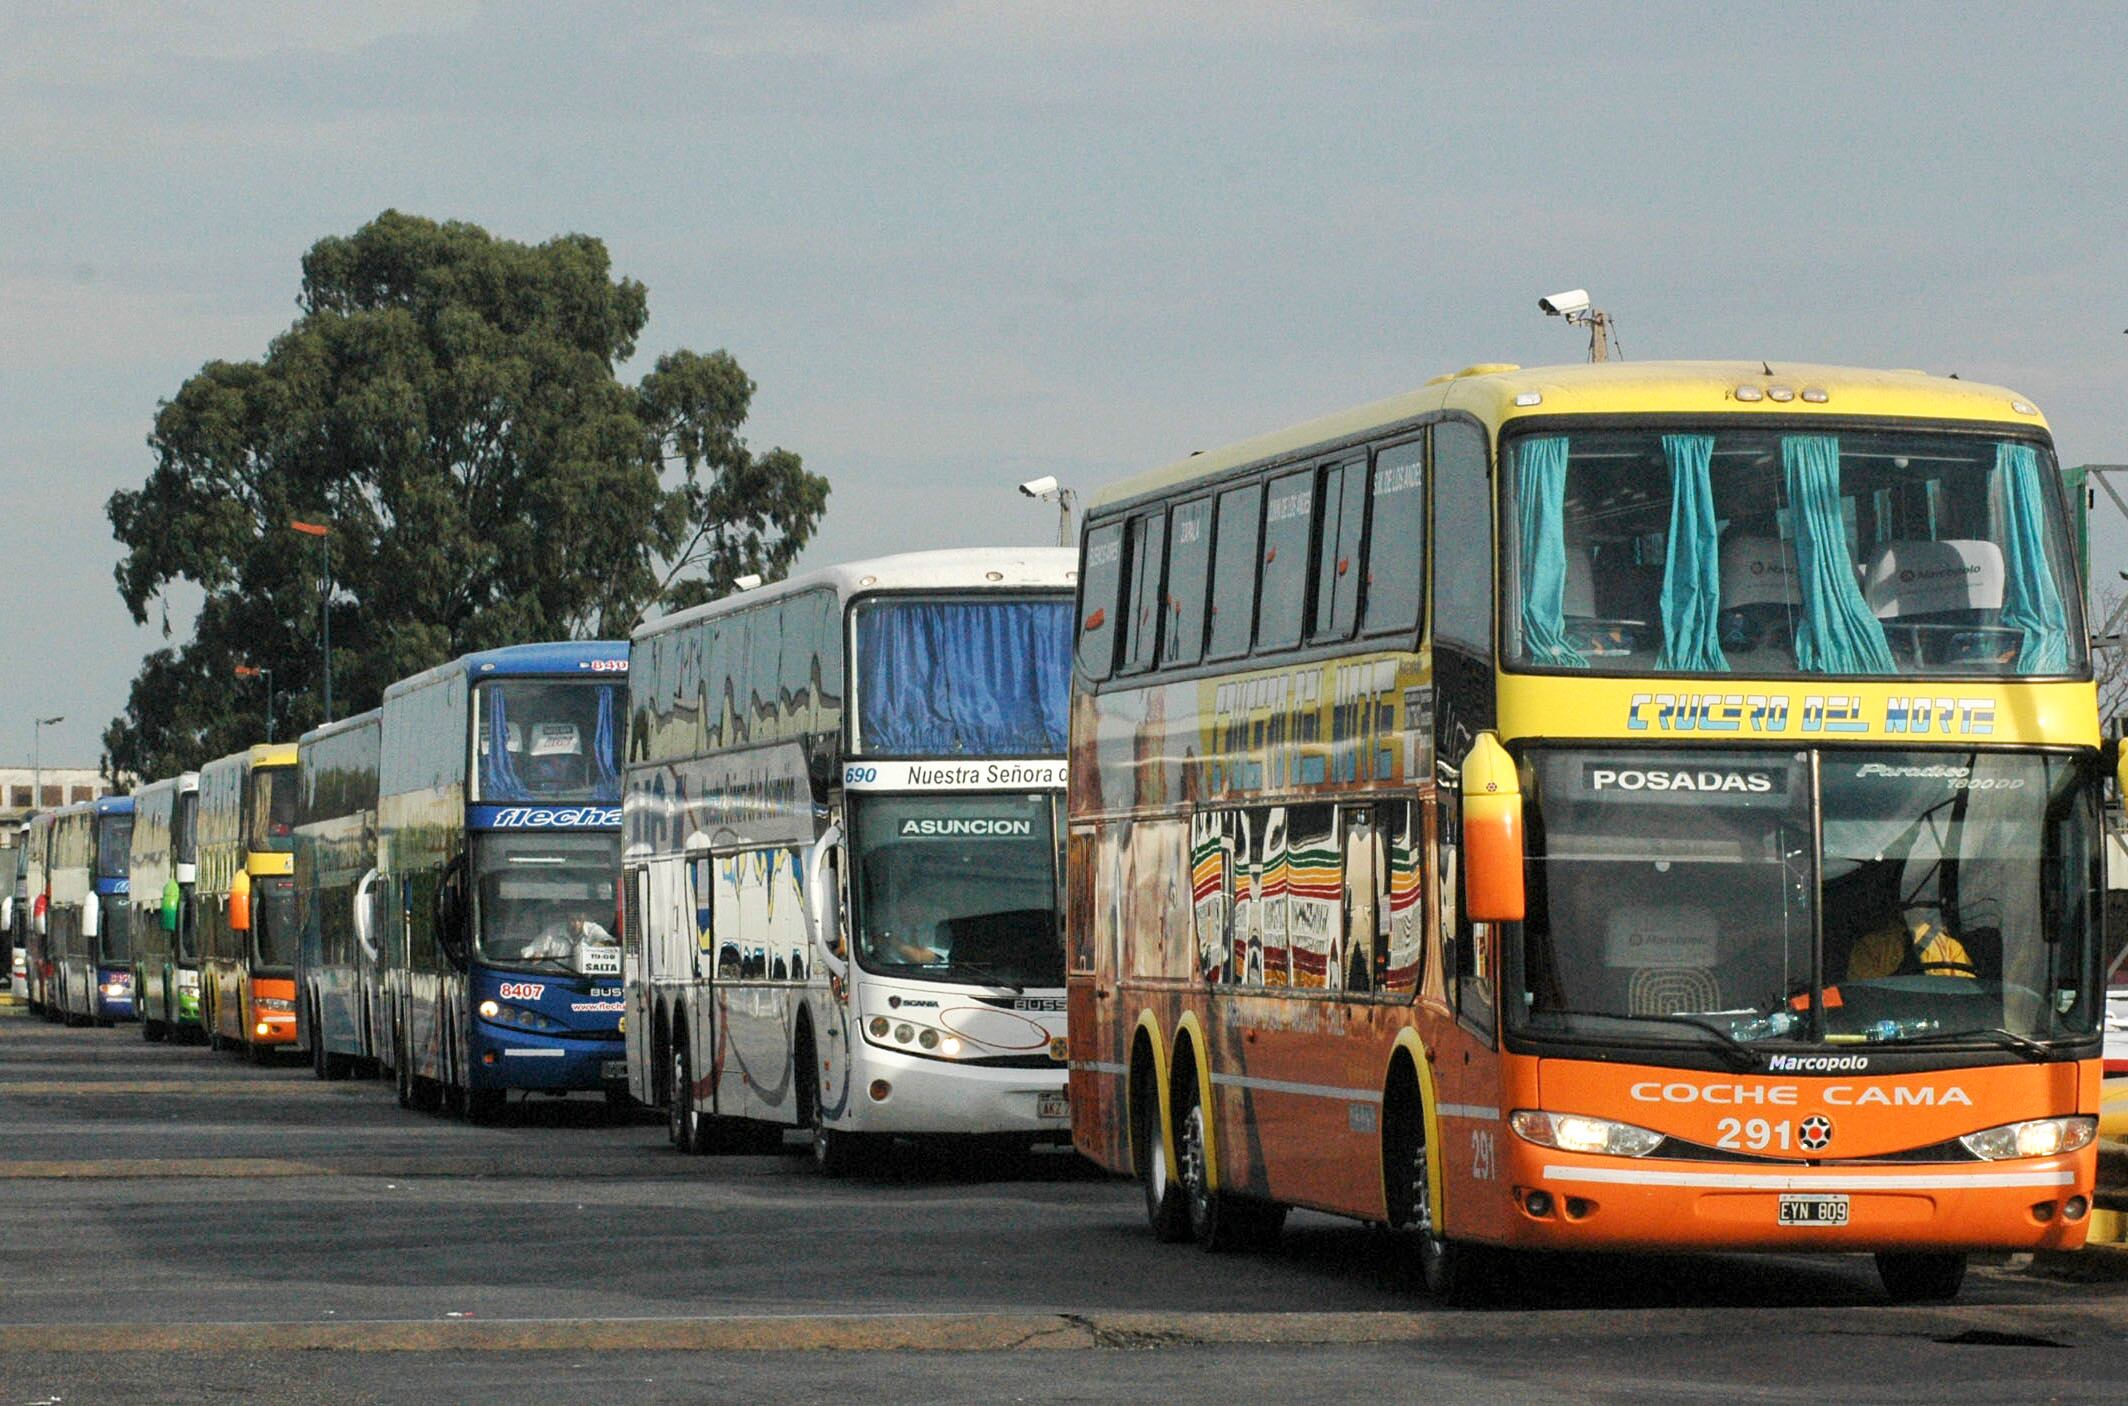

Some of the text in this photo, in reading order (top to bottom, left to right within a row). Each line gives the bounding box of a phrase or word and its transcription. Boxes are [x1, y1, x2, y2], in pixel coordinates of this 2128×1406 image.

[1627, 693, 1996, 735] CRUCERO DEL NORTE
[845, 767, 877, 783] 690
[907, 766, 980, 785] Nuestra
[986, 764, 1053, 784] Señora
[1856, 763, 1970, 778] Paradiso
[1592, 769, 1772, 792] POSADAS
[902, 819, 1031, 835] ASUNCION
[500, 983, 545, 1000] 8407
[590, 987, 625, 997] BUS
[903, 1000, 940, 1008] SCANIA
[1768, 1055, 1869, 1071] Marcopolo
[1630, 1082, 1973, 1106] COCHE CAMA
[1716, 1116, 1791, 1151] 291
[1472, 1129, 1496, 1181] 291
[1781, 1202, 1847, 1220] EYN 809
